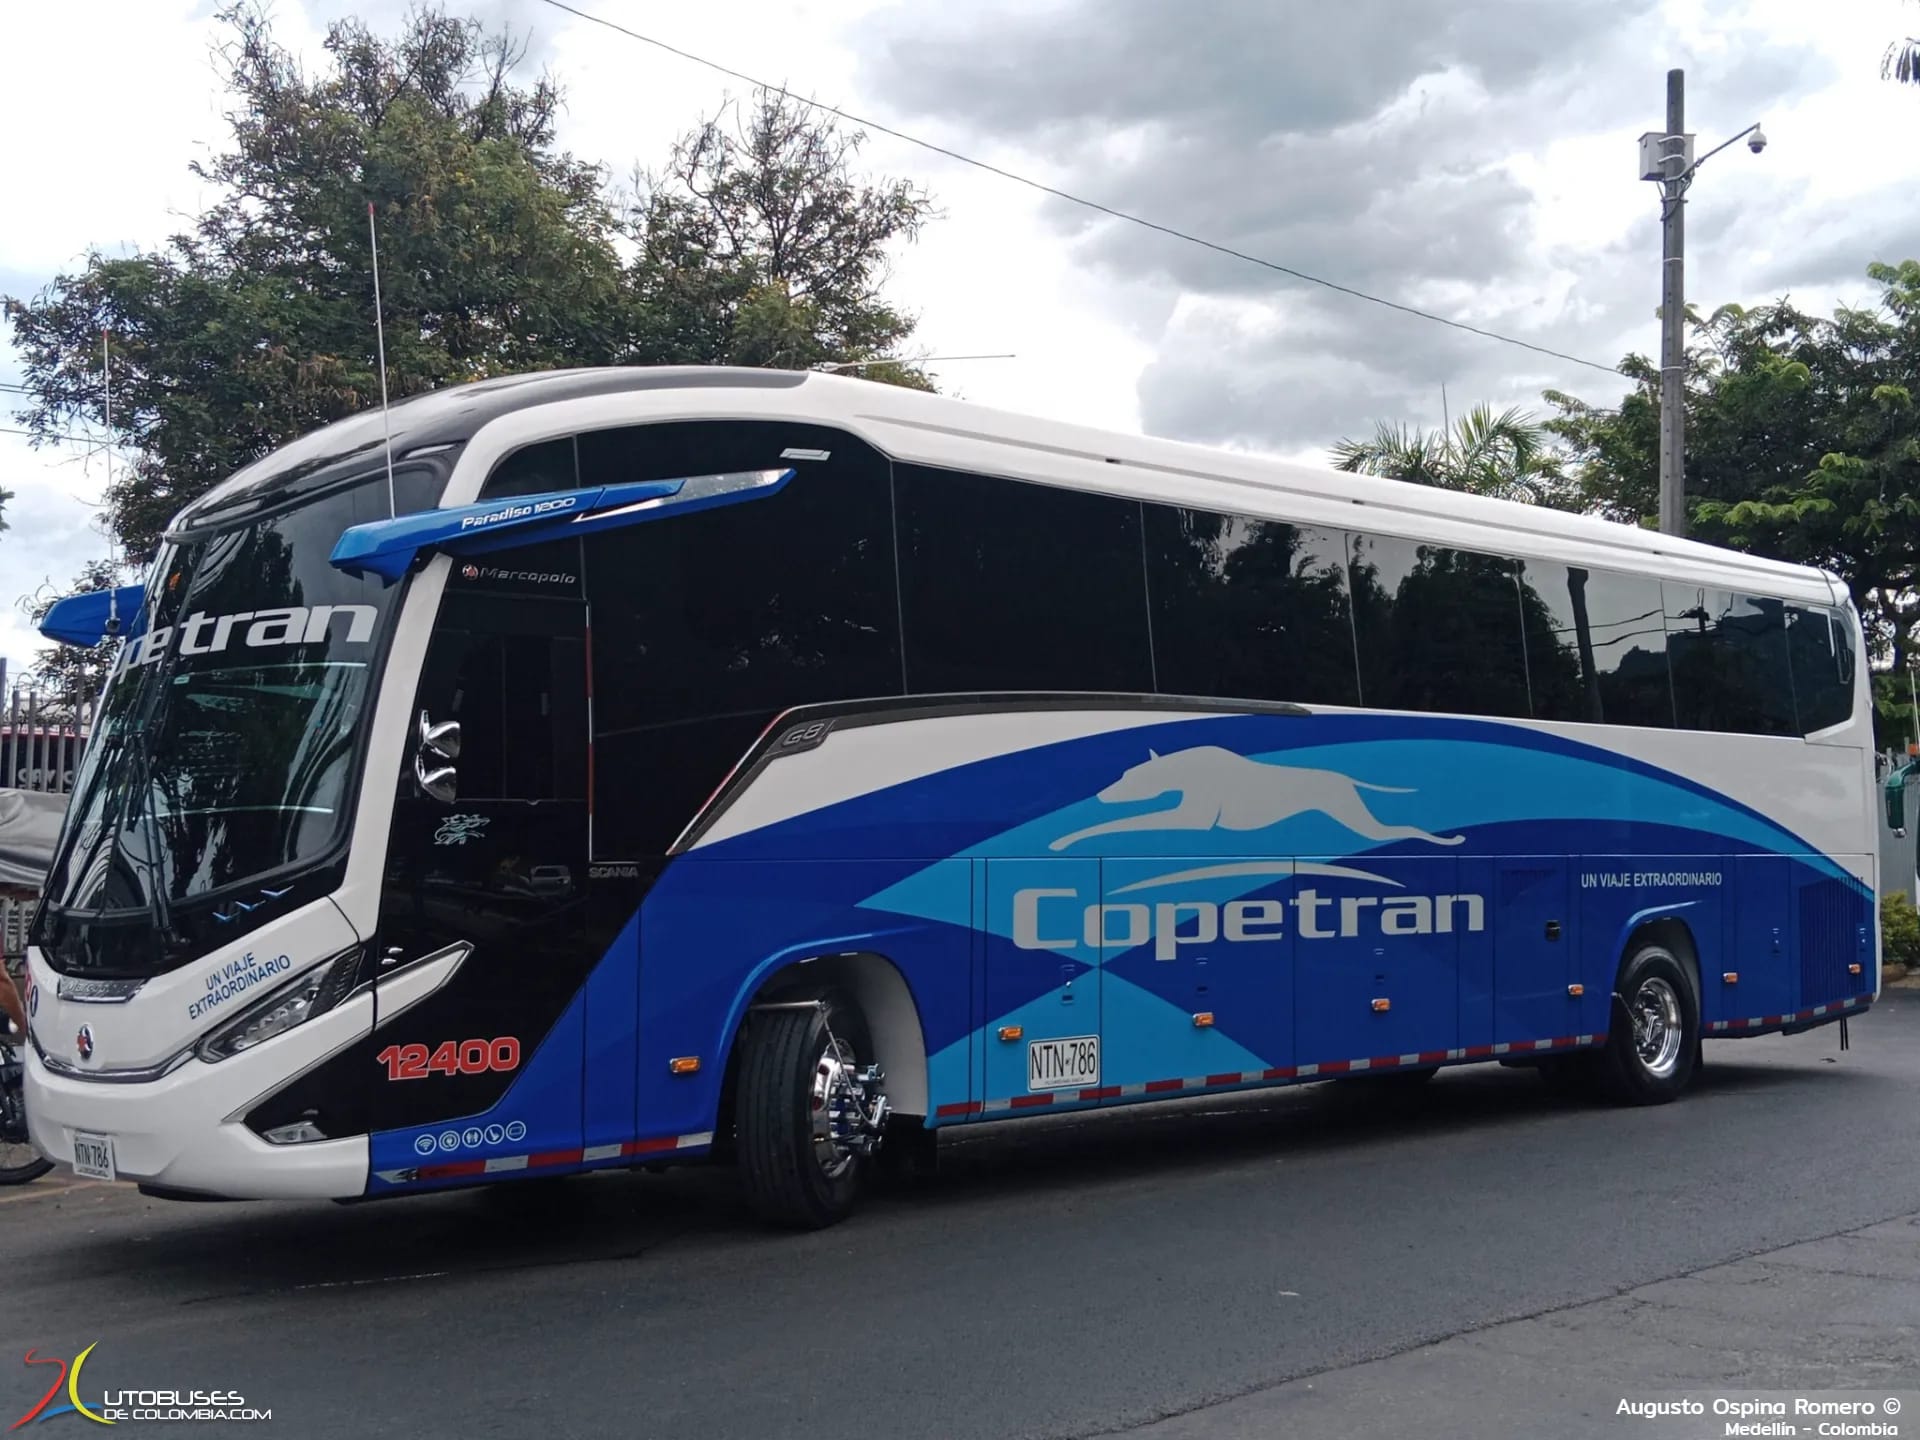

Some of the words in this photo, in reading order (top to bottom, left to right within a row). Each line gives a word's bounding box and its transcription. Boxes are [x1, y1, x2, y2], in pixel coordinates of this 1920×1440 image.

[461, 504, 532, 530] Paradiso
[534, 497, 577, 514] 1200
[480, 566, 576, 584] Marcopolo
[112, 604, 378, 685] petran
[783, 722, 825, 746] G8
[589, 866, 638, 878] SCANIA
[1581, 873, 1598, 888] UN
[1599, 873, 1631, 888] VIAJE
[1633, 872, 1722, 887] EXTRAORDINARIO
[1012, 888, 1486, 961] Copetran
[188, 954, 292, 1020] EXTRAORDINARIO
[205, 970, 222, 991] UN
[221, 952, 257, 980] VIAJE
[376, 1036, 520, 1081] 12400
